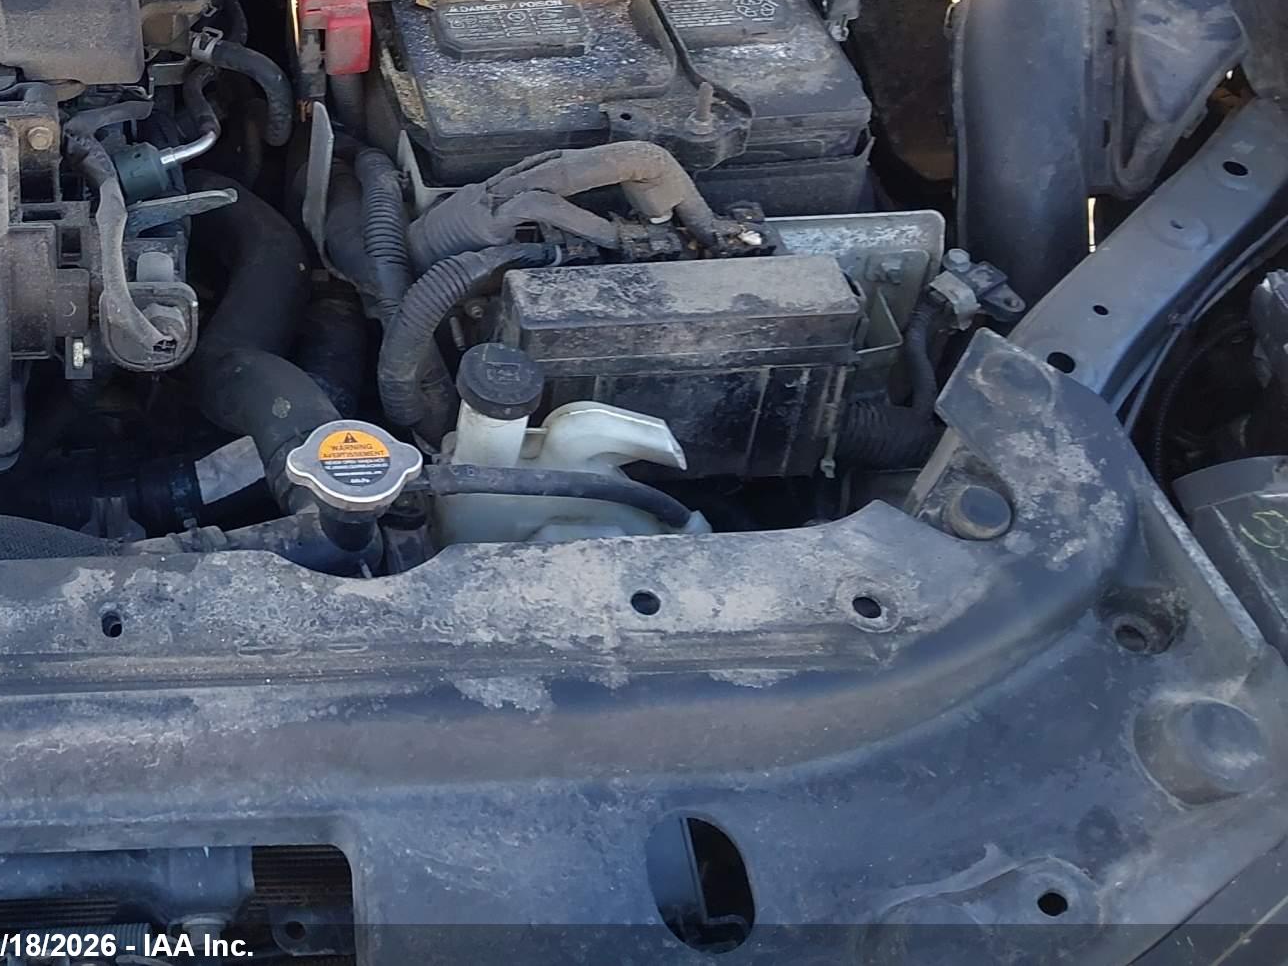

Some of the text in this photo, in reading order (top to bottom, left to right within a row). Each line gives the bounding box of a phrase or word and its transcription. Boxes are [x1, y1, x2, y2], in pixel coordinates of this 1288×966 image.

[460, 4, 508, 12] DANGER
[519, 0, 563, 8] POISON
[323, 450, 384, 458] AVERTISSEMENT
